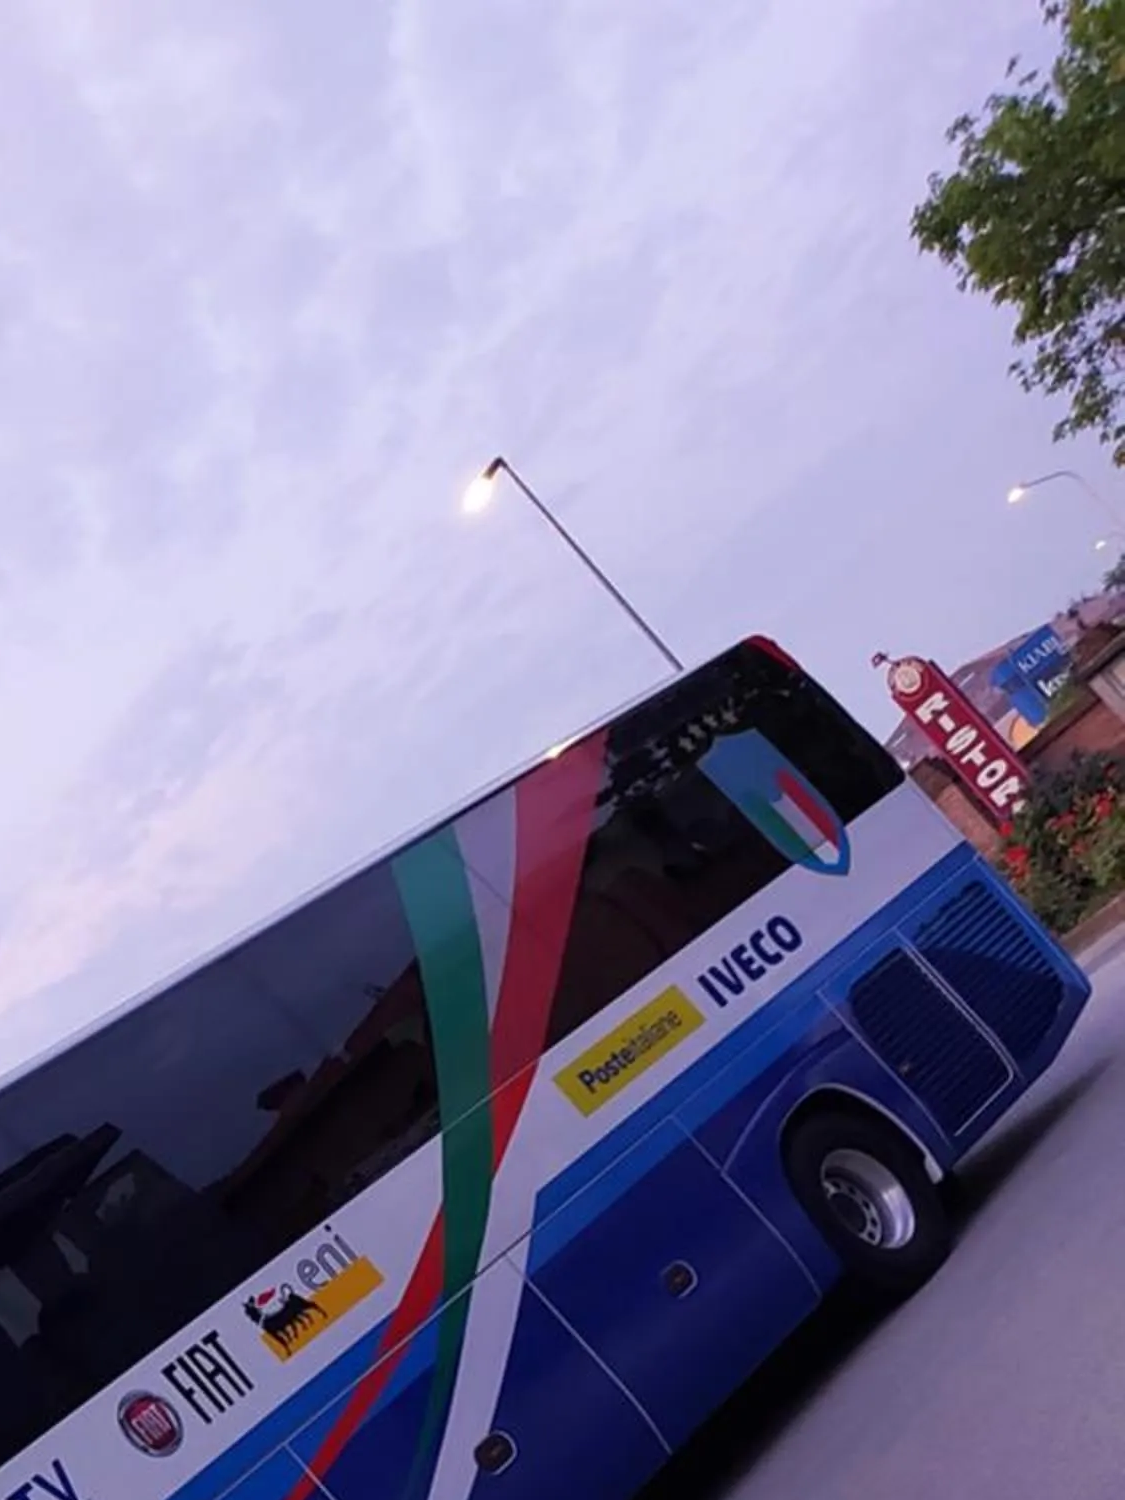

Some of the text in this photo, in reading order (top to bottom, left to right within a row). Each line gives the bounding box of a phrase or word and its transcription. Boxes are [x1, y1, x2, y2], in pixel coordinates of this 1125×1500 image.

[697, 915, 803, 1008] IVECO
[295, 1223, 358, 1293] eni
[161, 1329, 255, 1425] FIAT
